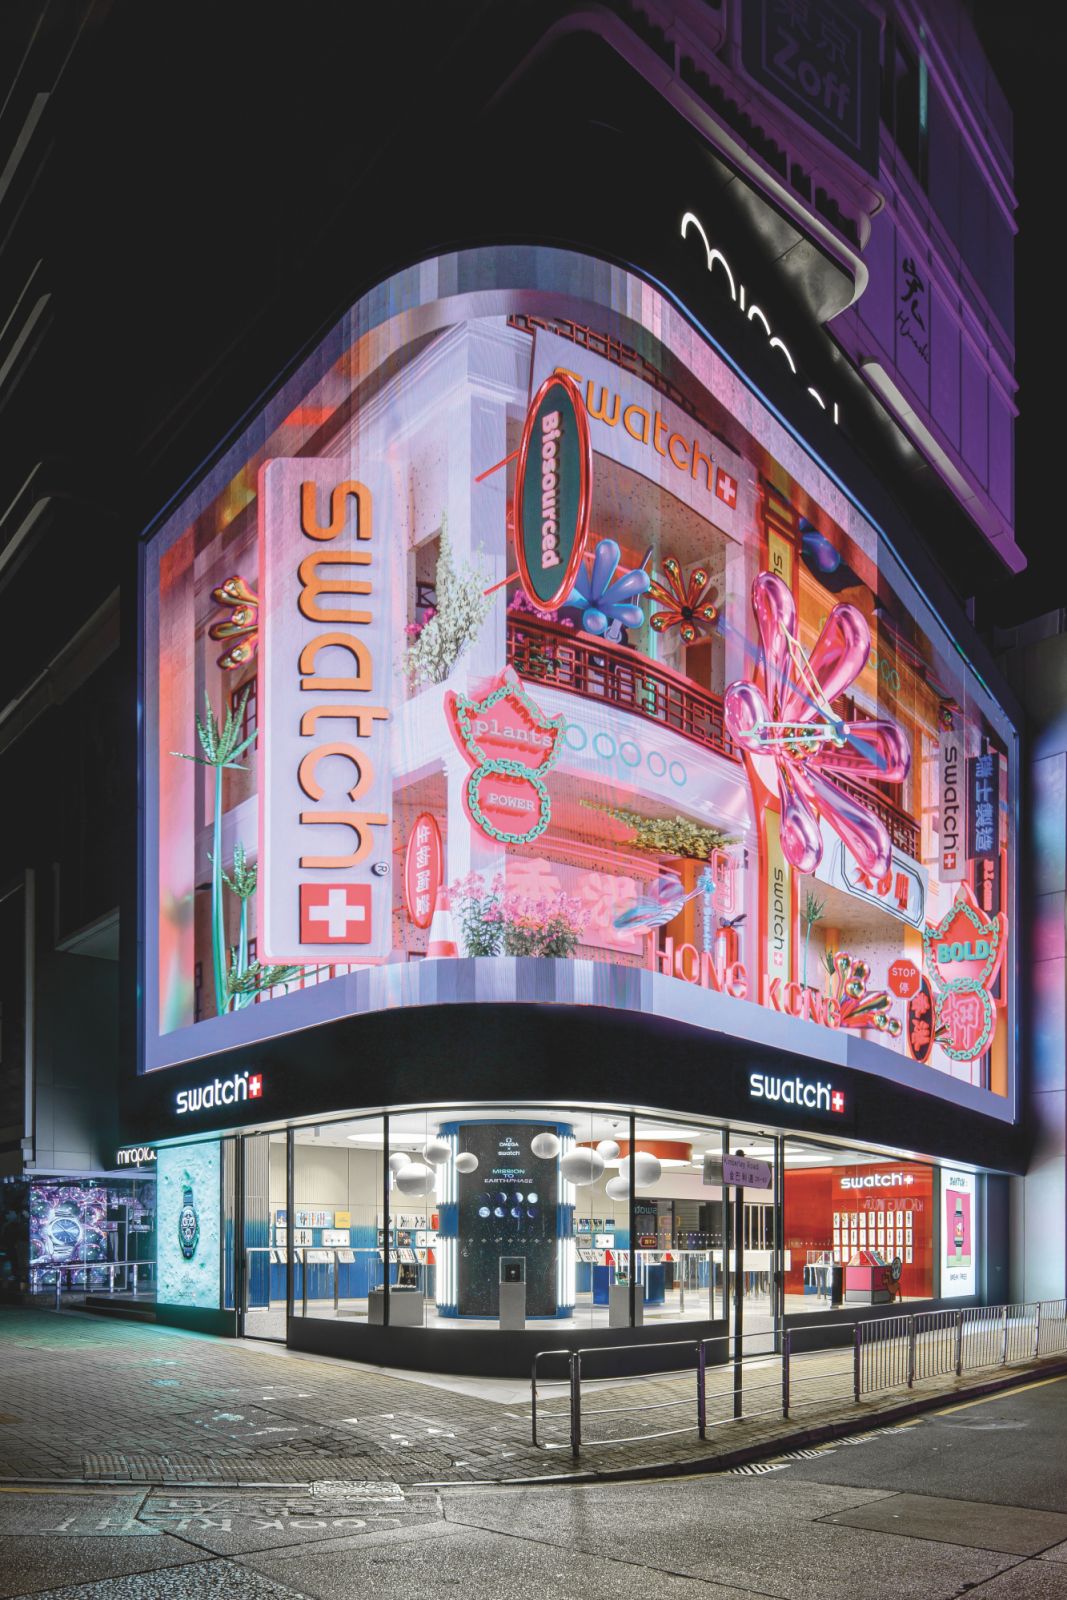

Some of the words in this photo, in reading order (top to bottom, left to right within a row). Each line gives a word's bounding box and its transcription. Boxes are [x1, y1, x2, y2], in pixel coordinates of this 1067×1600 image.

[773, 25, 850, 121] Zoff
[554, 367, 714, 493] watch
[542, 410, 561, 570] Biosourced
[473, 719, 554, 748] plants
[488, 793, 535, 810] POWER
[943, 746, 959, 851] swatch
[773, 867, 786, 951] swatch
[892, 967, 916, 977] STOP
[937, 940, 991, 964] BOLD
[645, 929, 749, 999] HONG
[763, 974, 842, 1030] KONG
[176, 1072, 249, 1114] swatch
[750, 1073, 831, 1111] swatch
[840, 1173, 902, 1189] swatch
[251, 1518, 401, 1532] LOOK
